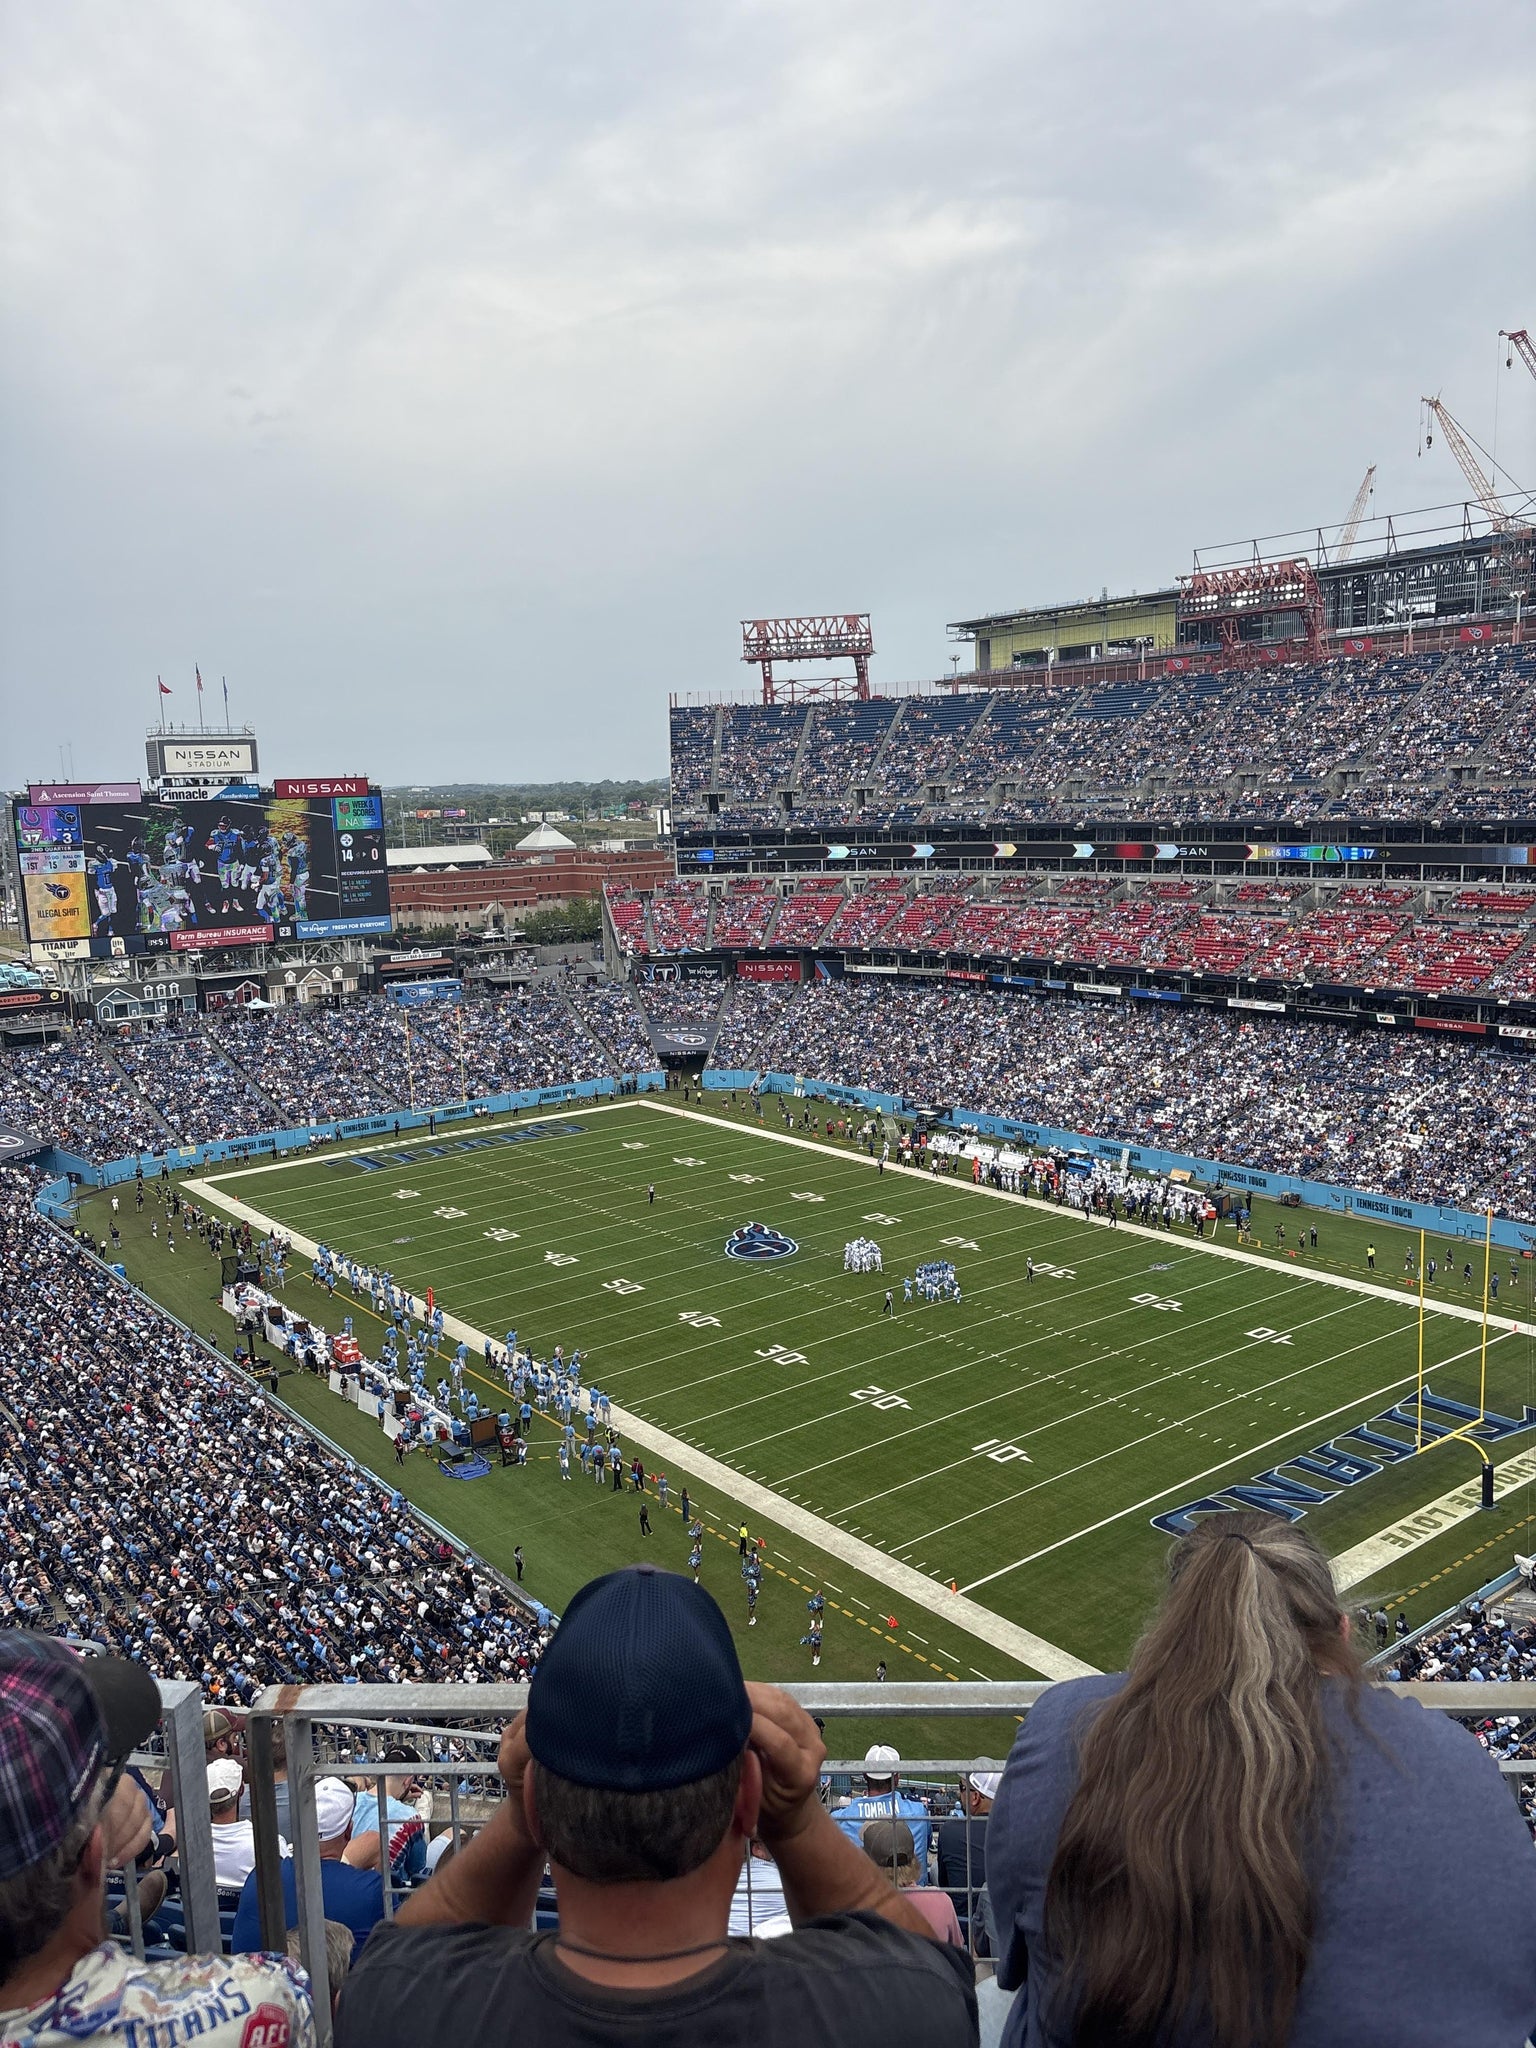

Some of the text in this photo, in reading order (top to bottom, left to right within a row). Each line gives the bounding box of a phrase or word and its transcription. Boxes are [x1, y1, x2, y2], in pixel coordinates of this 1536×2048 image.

[175, 750, 240, 760] NISSAN
[160, 788, 208, 800] Pinnacle
[288, 783, 357, 794] NISSAN
[352, 800, 368, 808] WEEK
[352, 808, 376, 816] SCORES
[25, 834, 40, 844] 17
[62, 833, 72, 844] 3
[342, 850, 354, 862] 14
[372, 848, 378, 860] 0
[1264, 848, 1274, 856] 1st
[1362, 849, 1374, 860] 17
[26, 862, 38, 870] 1ST
[48, 860, 58, 870] 15
[37, 908, 80, 919] ILLEGAL SHIFT
[176, 933, 195, 941] Farm
[223, 927, 267, 936] INSURANCE
[41, 941, 79, 951] TITAN UP
[342, 1119, 387, 1134] TENNESSEE TOUGH
[228, 1138, 276, 1154] TENNESSEE TOUGH
[13, 1148, 40, 1160] NISSAN
[1218, 1169, 1246, 1184] TENNESSEE
[432, 1208, 468, 1219] 20
[1356, 1198, 1412, 1219] TENNESSEE TOUGH
[861, 1212, 902, 1225] 50
[483, 1229, 520, 1241] 30
[938, 1236, 977, 1250] 40
[544, 1253, 580, 1266] 40
[1031, 1263, 1074, 1279] 30
[601, 1278, 646, 1295] 50
[1128, 1293, 1180, 1310] 20
[678, 1312, 720, 1328] 40
[1244, 1327, 1293, 1344] 10
[754, 1344, 808, 1366] 30
[850, 1386, 908, 1410] 20
[972, 1438, 1028, 1463] 10
[1380, 1507, 1458, 1548] LOVE
[112, 1977, 251, 2048] TITANS
[251, 2024, 290, 2048] AFC
